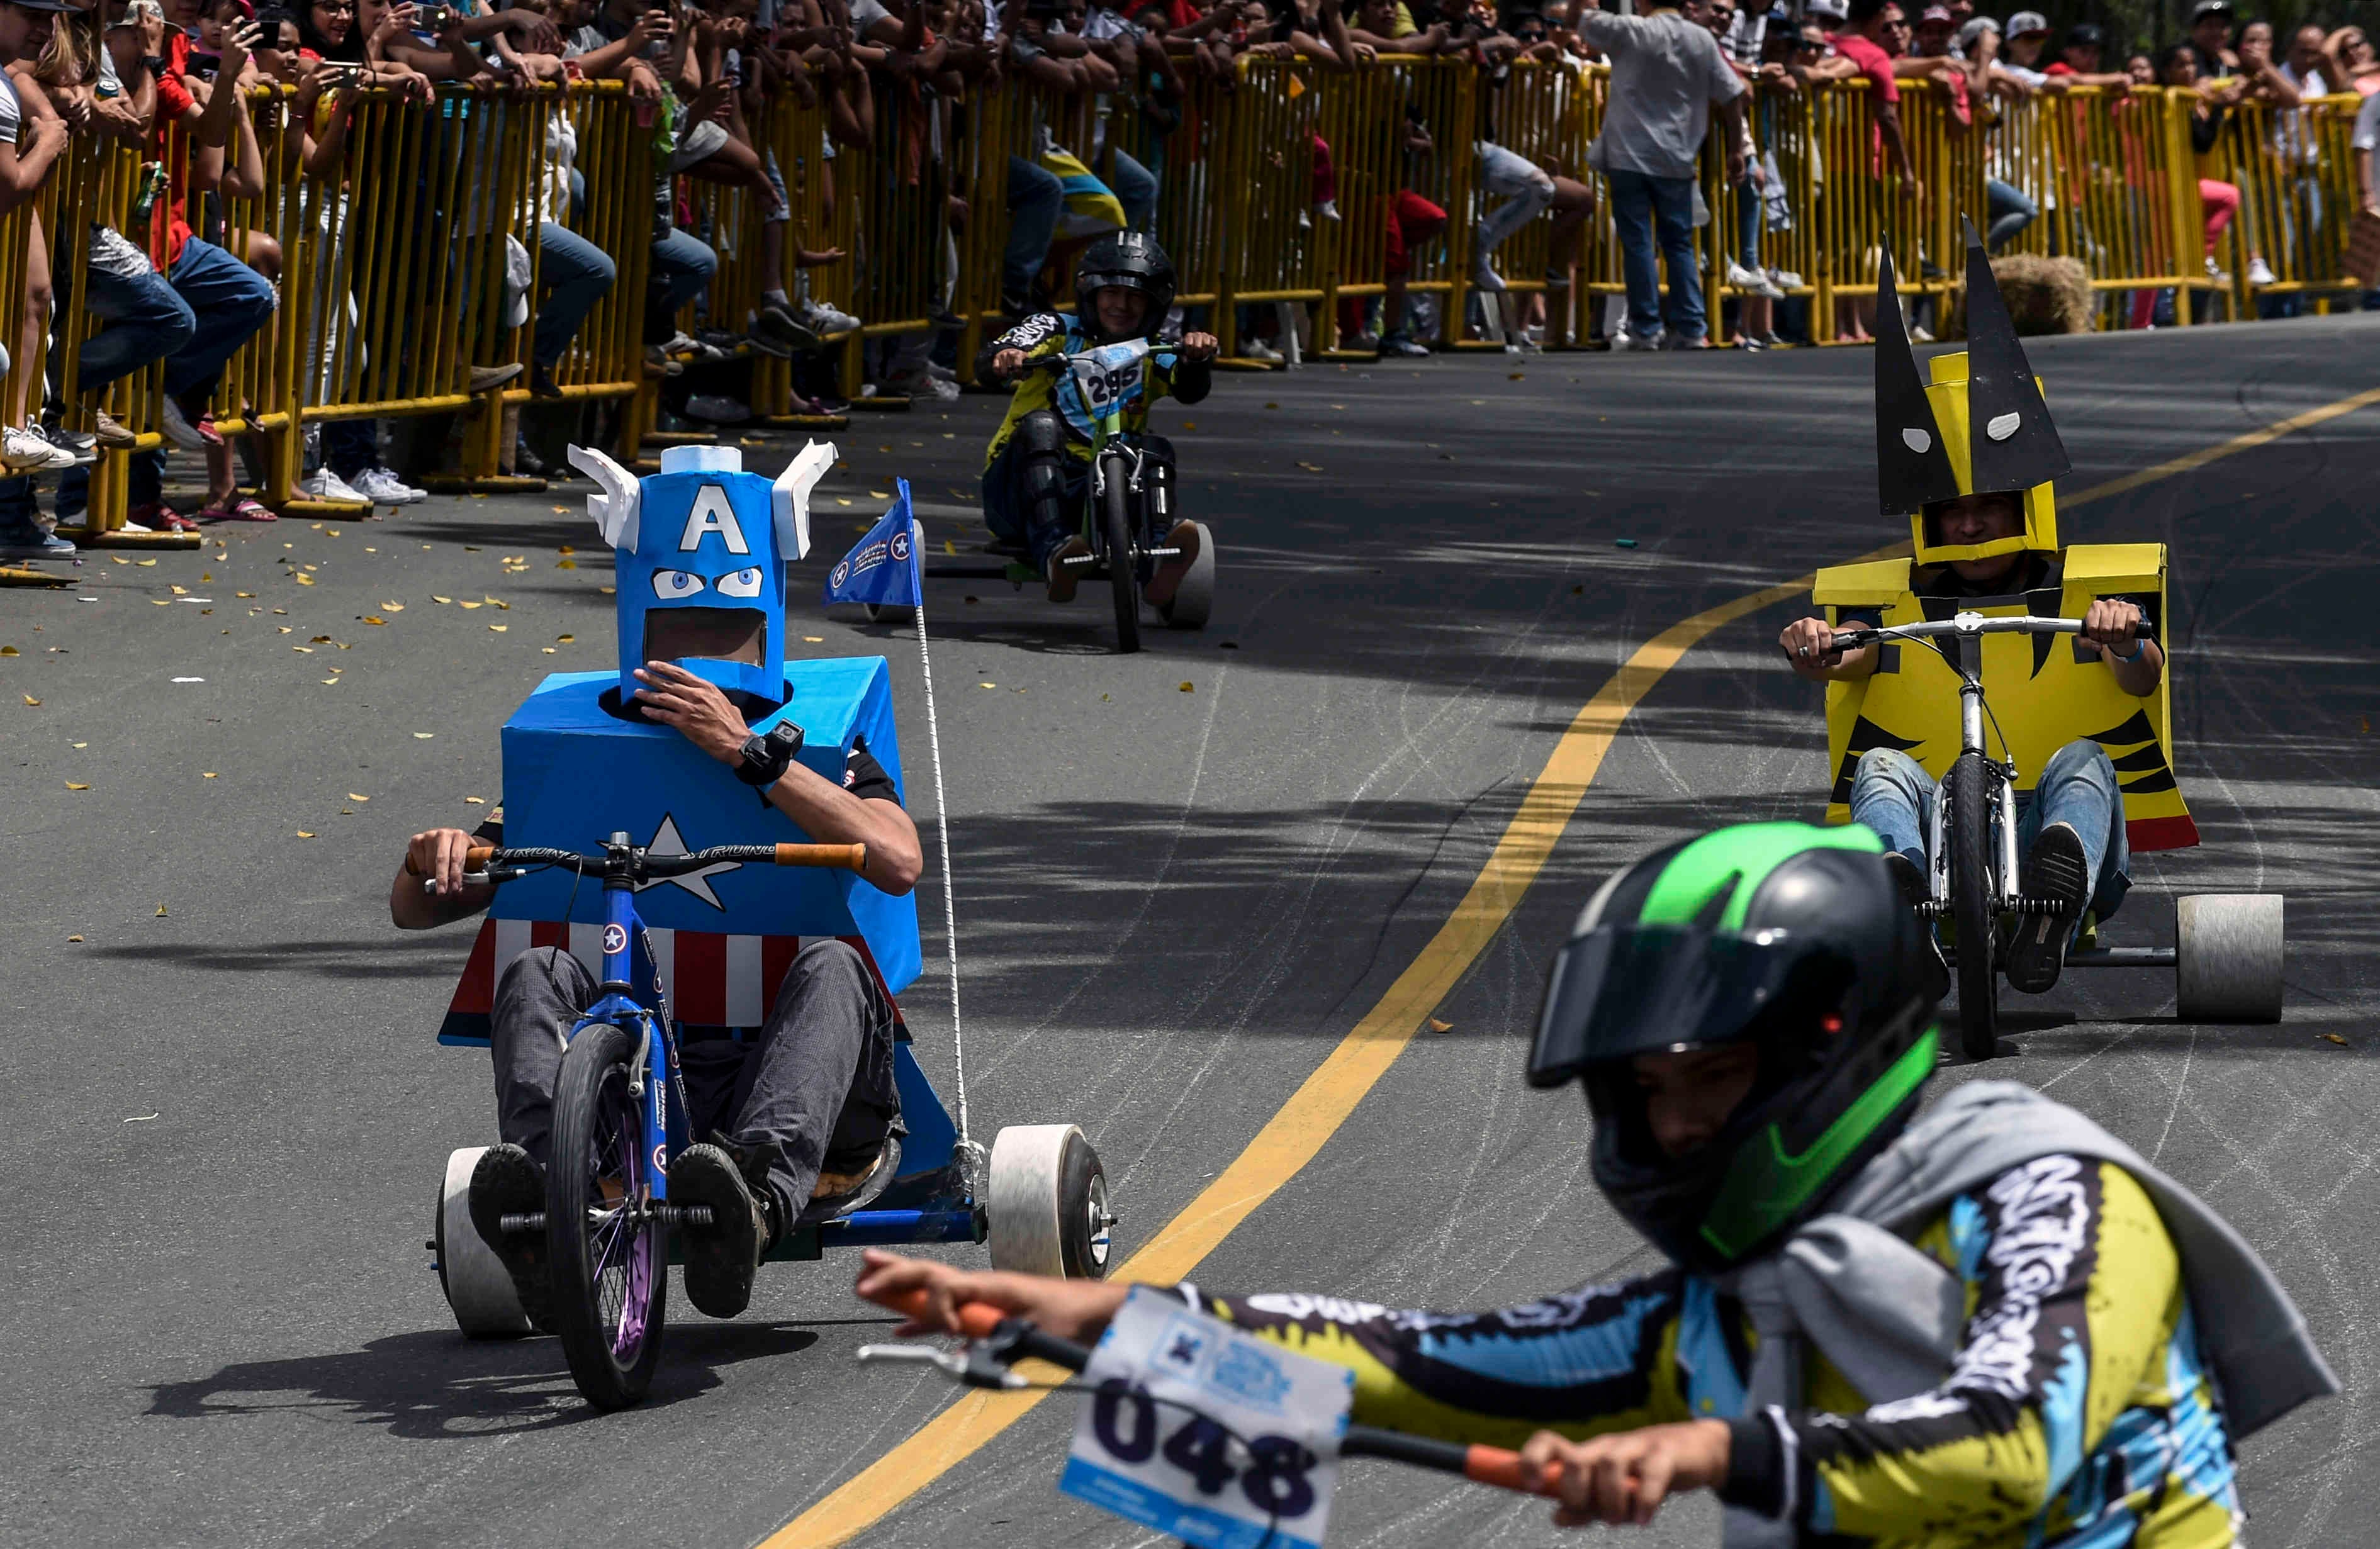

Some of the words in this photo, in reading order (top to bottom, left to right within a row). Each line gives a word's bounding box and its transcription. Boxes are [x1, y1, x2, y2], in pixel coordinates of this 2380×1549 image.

[1088, 366, 1138, 403] 295
[678, 484, 751, 556] A
[1094, 1378, 1316, 1519] 048
